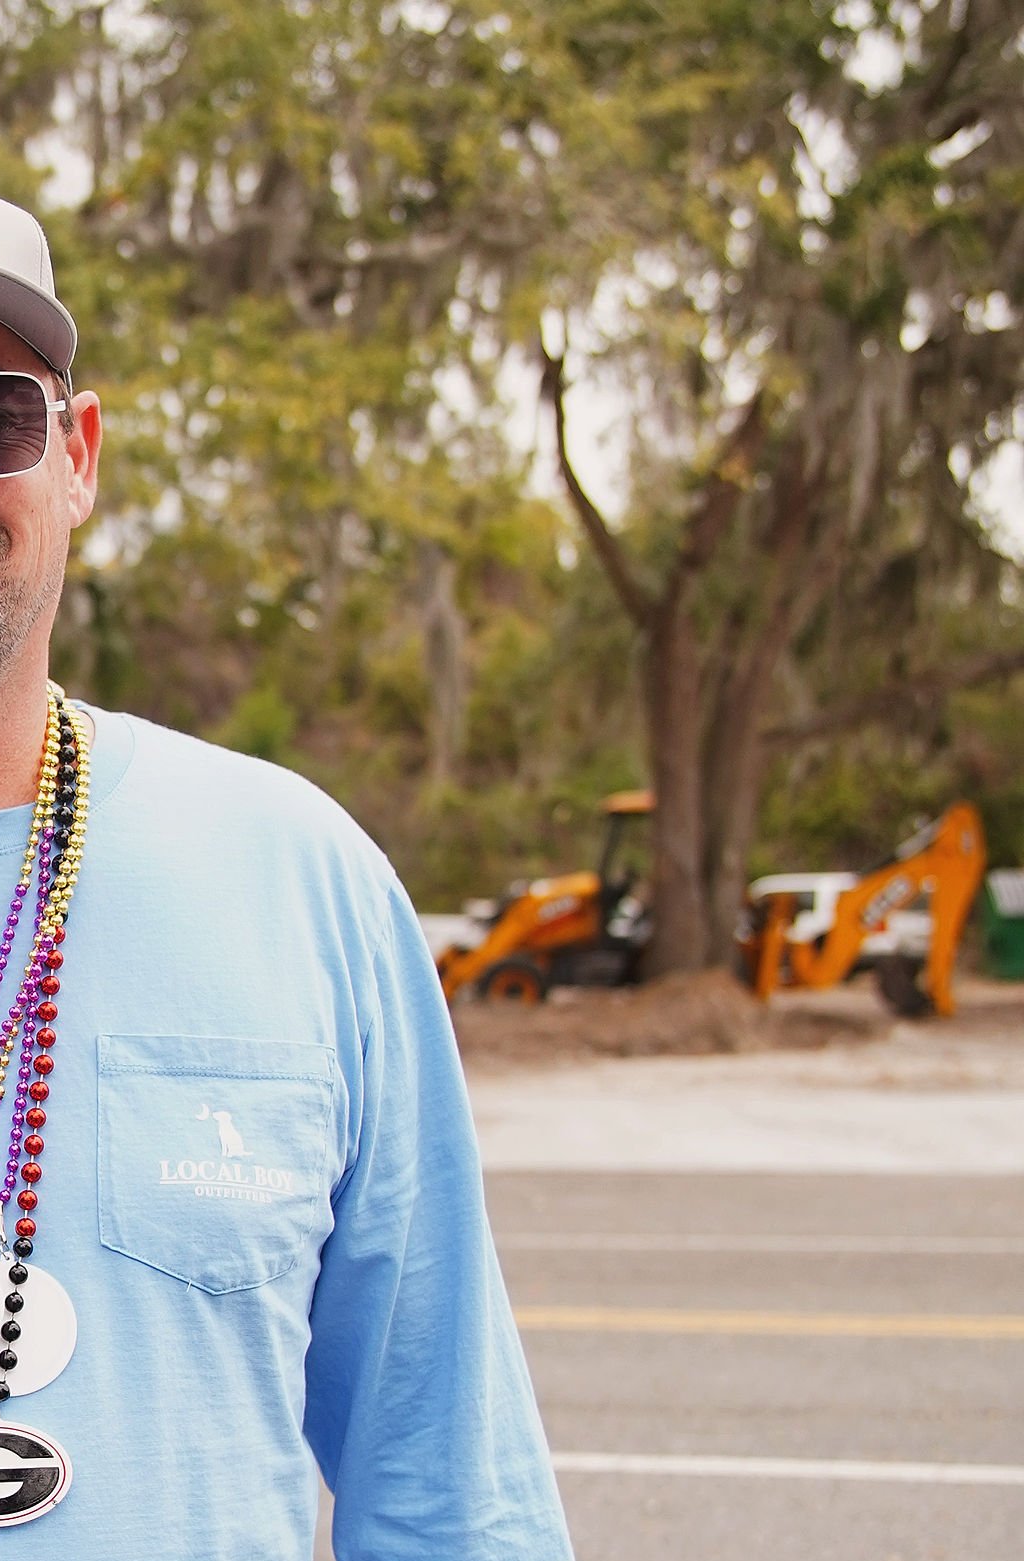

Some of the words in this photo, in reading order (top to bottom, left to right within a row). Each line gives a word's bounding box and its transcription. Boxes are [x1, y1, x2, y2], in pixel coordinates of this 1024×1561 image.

[160, 1160, 248, 1184] LOCAL
[254, 1165, 294, 1191] BOY
[194, 1186, 272, 1203] OUTFITTERS
